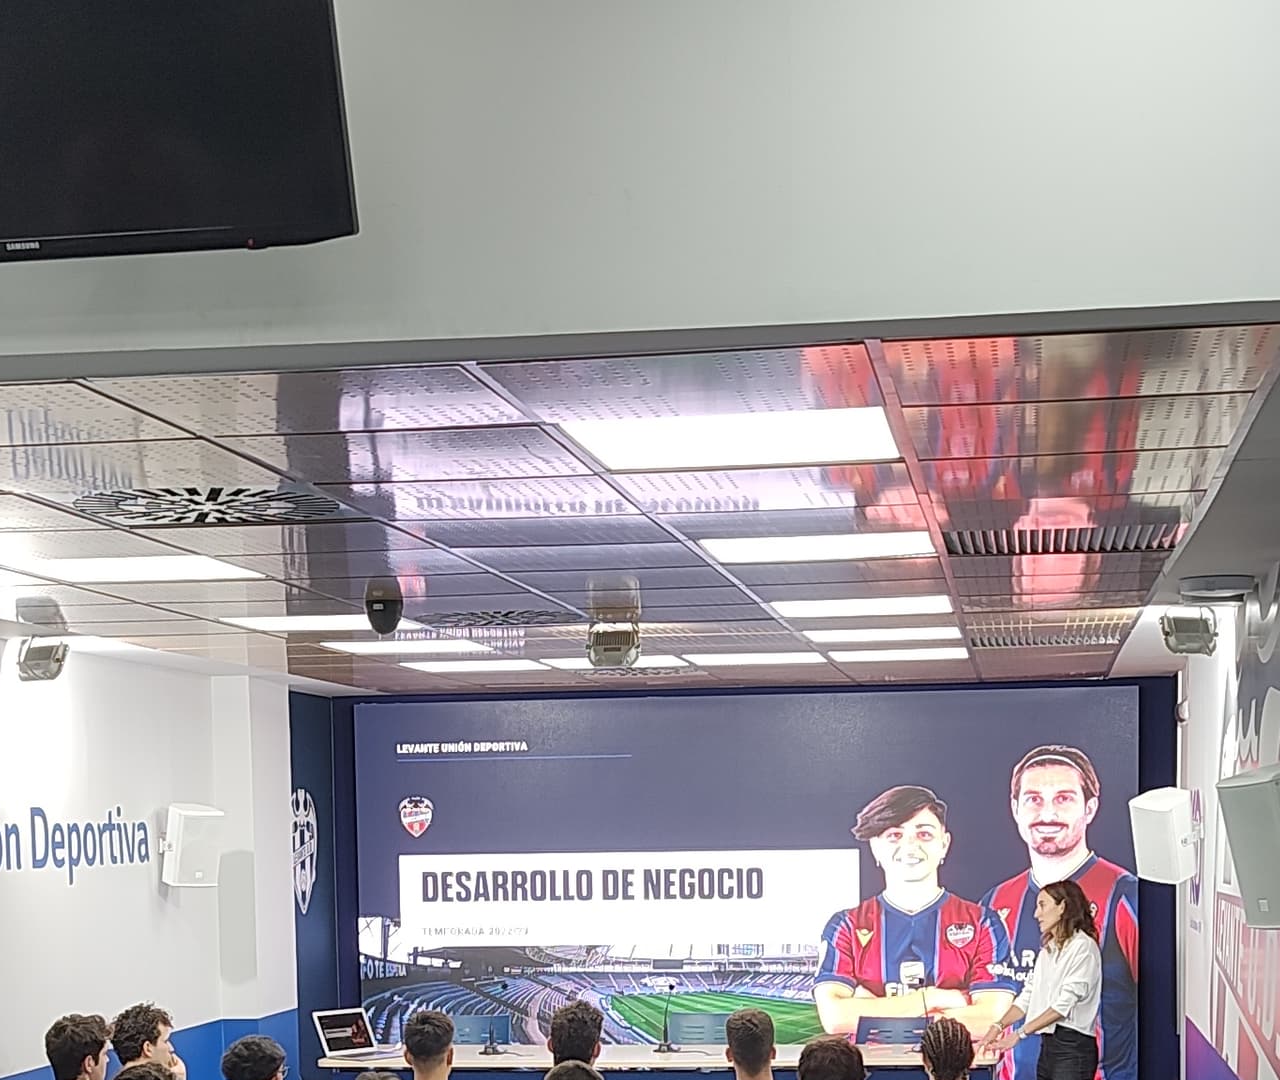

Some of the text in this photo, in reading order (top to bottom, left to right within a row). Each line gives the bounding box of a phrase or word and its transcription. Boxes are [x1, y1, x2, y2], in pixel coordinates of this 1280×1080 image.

[397, 740, 528, 754] LEVANTE UNIÓN DEPORTIVA
[30, 805, 150, 887] Deportiva
[422, 868, 763, 902] DESARROLLO DE NEGOCIO
